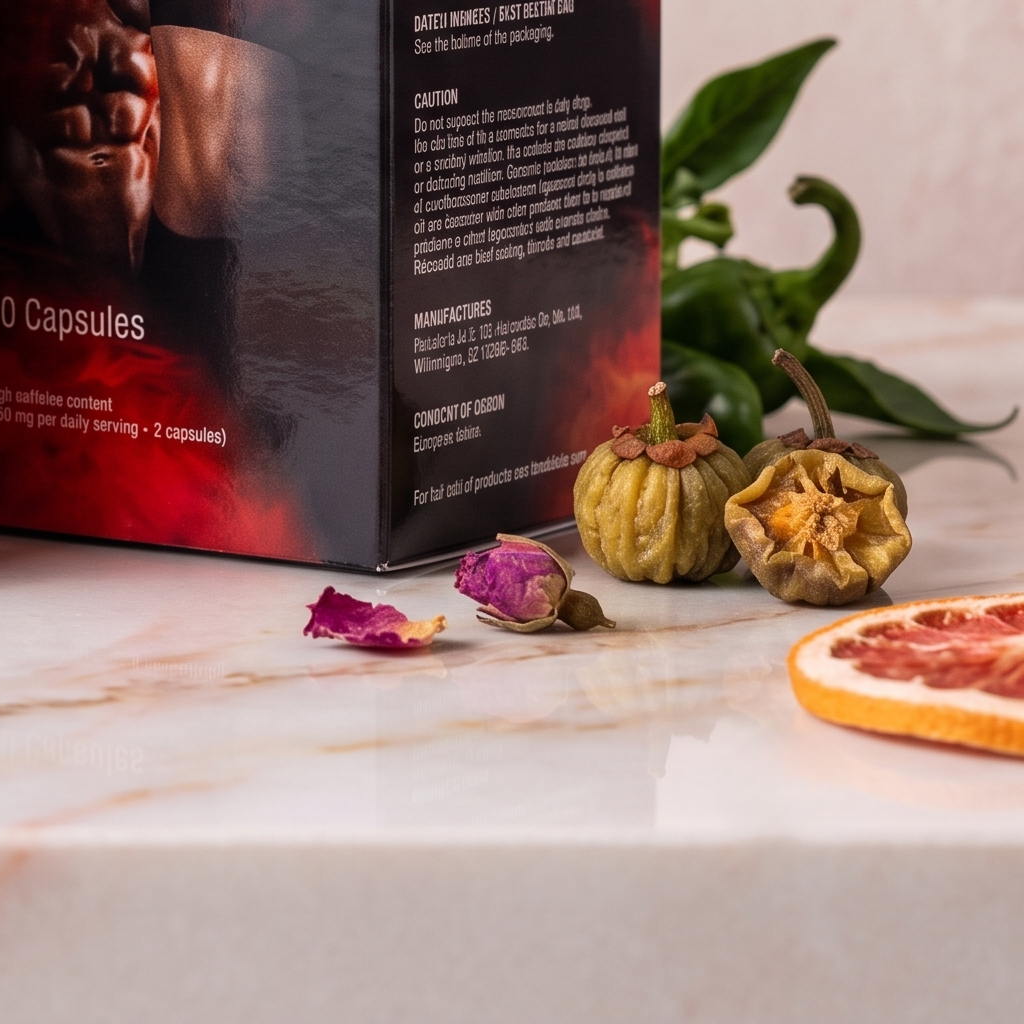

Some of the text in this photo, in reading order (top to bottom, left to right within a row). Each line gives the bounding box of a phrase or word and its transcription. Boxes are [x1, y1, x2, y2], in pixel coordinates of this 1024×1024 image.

[414, 39, 432, 55] See
[435, 37, 449, 53] the
[484, 32, 493, 46] of
[414, 88, 458, 109] CAUTION
[414, 118, 427, 133] Do
[430, 116, 444, 131] not
[482, 108, 495, 123] the
[26, 298, 145, 342] Capsules
[67, 396, 113, 412] content
[460, 400, 472, 419] OF
[16, 413, 34, 428] mg
[38, 414, 57, 429] per
[60, 414, 89, 434] daily
[93, 418, 139, 439] serving
[154, 422, 162, 438] 2
[166, 426, 227, 447] capsules)
[414, 490, 429, 506] For
[464, 476, 473, 493] of
